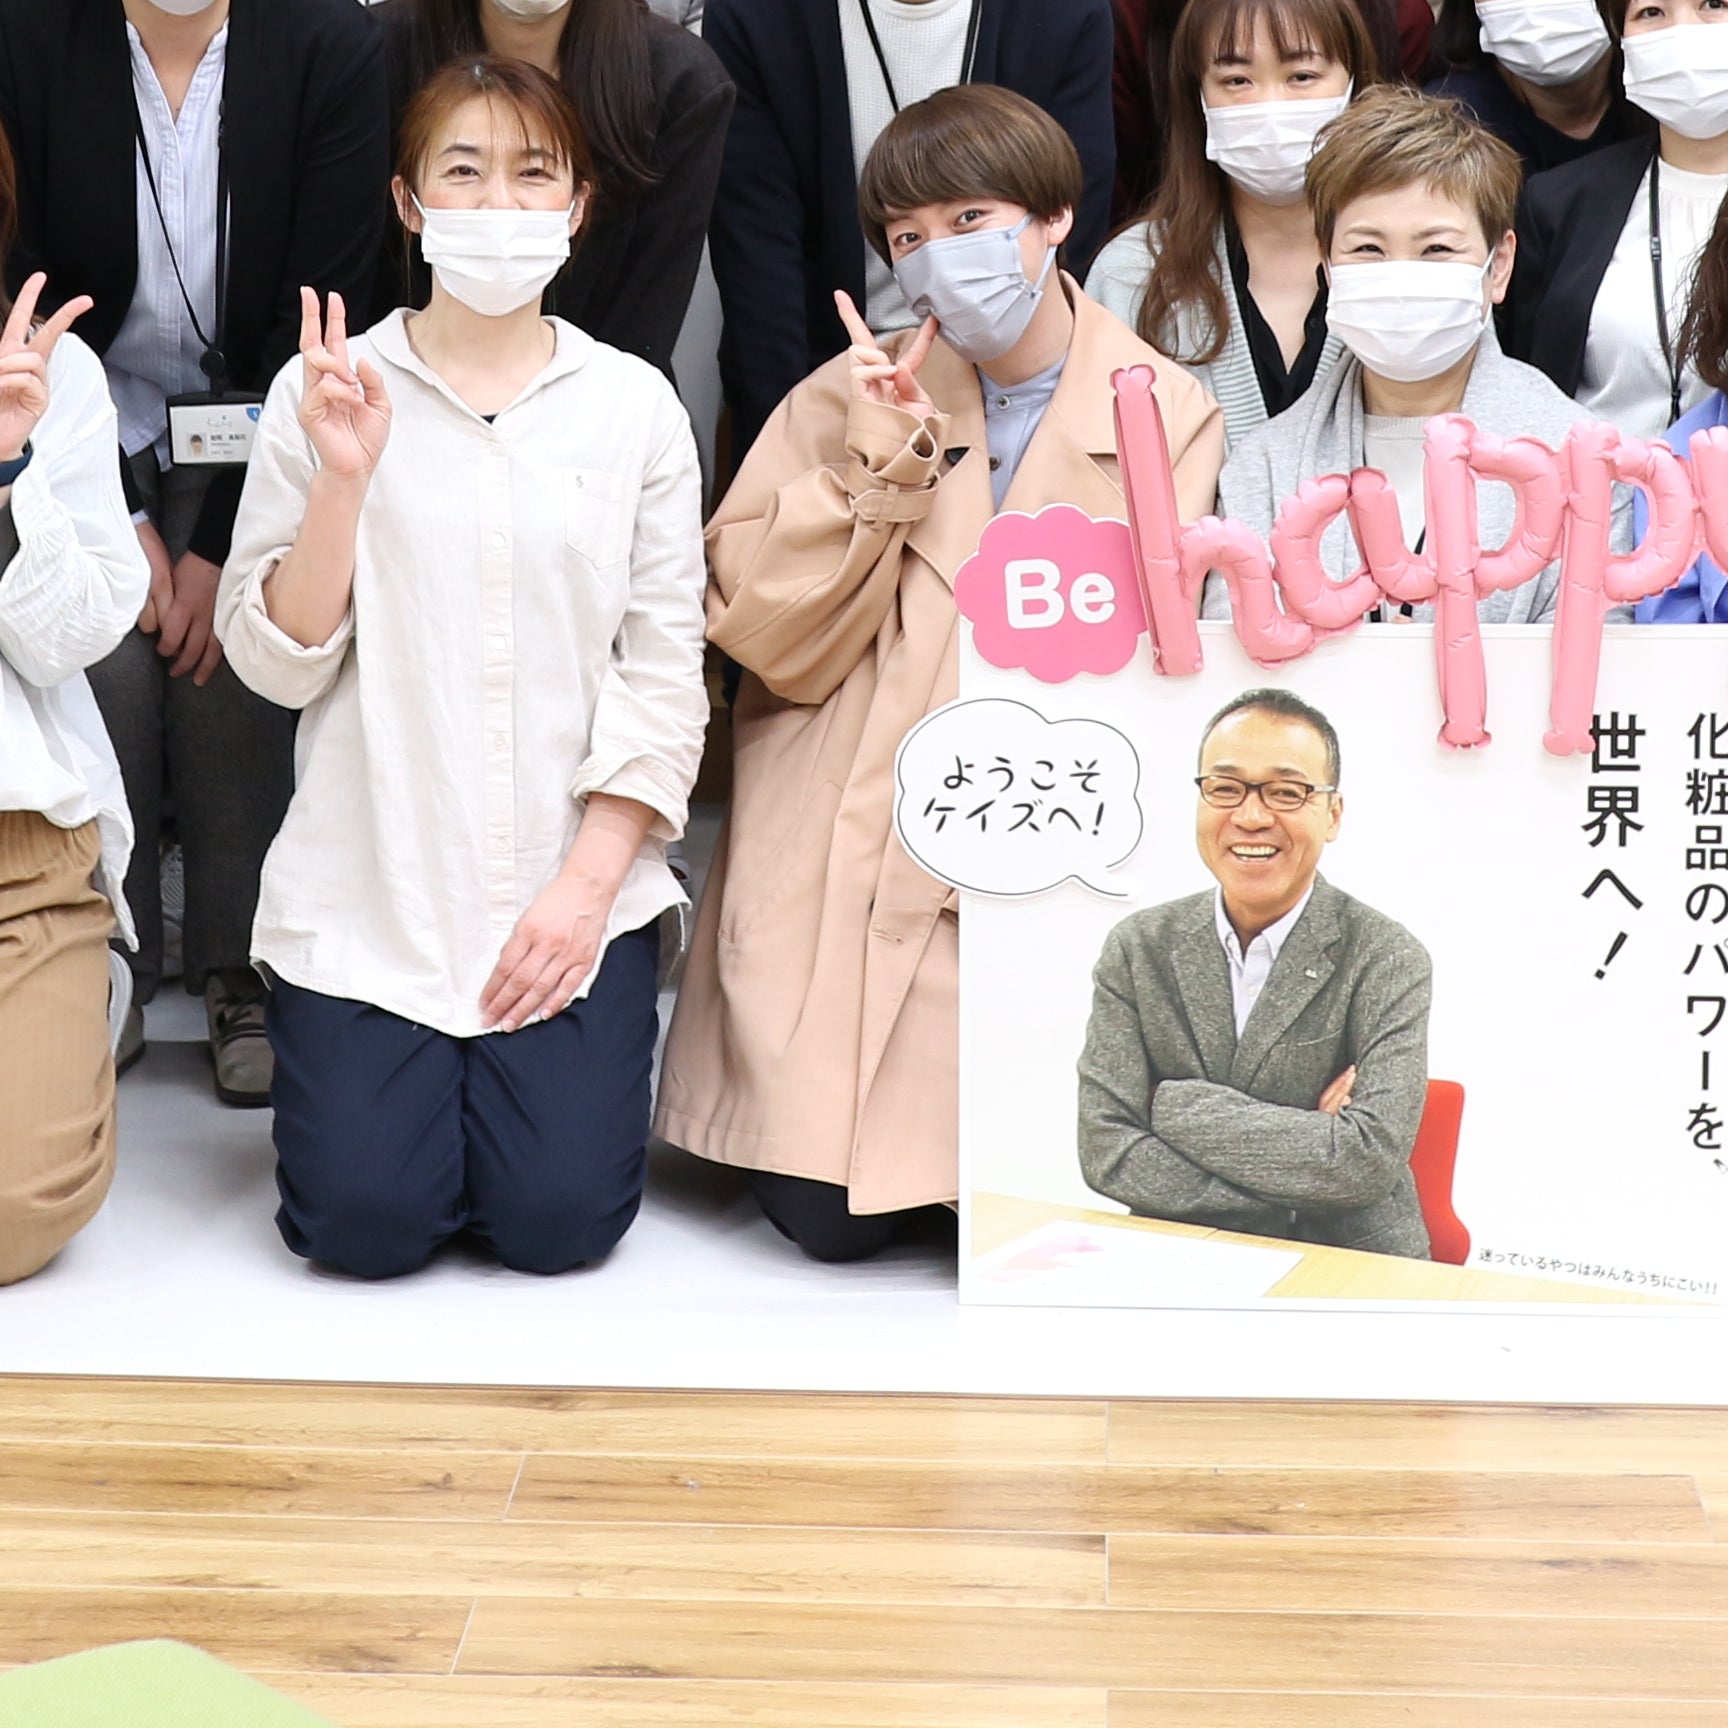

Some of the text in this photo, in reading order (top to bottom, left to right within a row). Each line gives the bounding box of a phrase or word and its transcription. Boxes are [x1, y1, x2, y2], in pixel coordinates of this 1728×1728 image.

[1003, 558, 1116, 629] Be
[943, 754, 1102, 793] ようこそ
[923, 797, 1105, 836] ケイズへ！
[1581, 711, 1646, 980] 世界へ！
